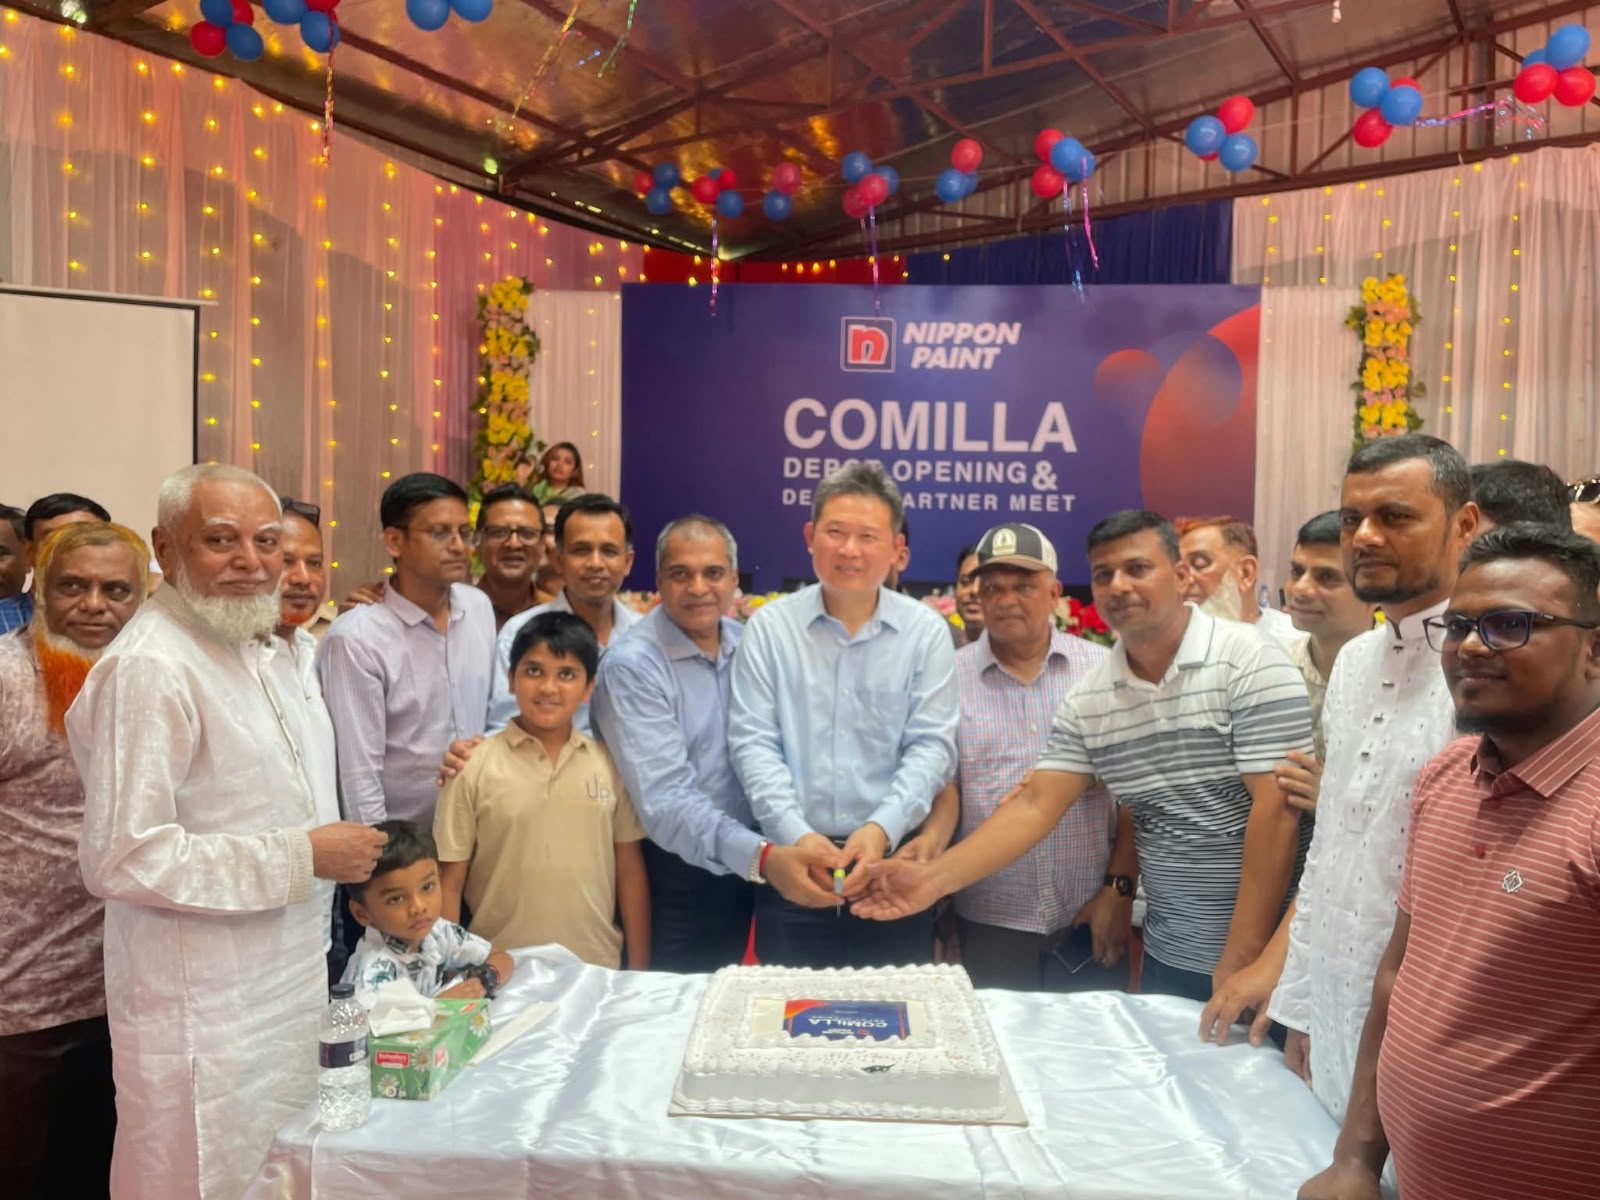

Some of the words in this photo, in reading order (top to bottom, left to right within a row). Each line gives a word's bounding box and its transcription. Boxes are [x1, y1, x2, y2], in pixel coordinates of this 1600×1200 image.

[903, 322, 1021, 345] NIPPON
[911, 347, 1001, 369] PAINT
[784, 398, 1077, 452] COMILLA
[892, 460, 1027, 484] OPENING
[1032, 460, 1058, 491] &
[902, 492, 998, 511] ARTNER
[1009, 494, 1075, 512] MEET
[808, 1017, 888, 1028] COMILLA
